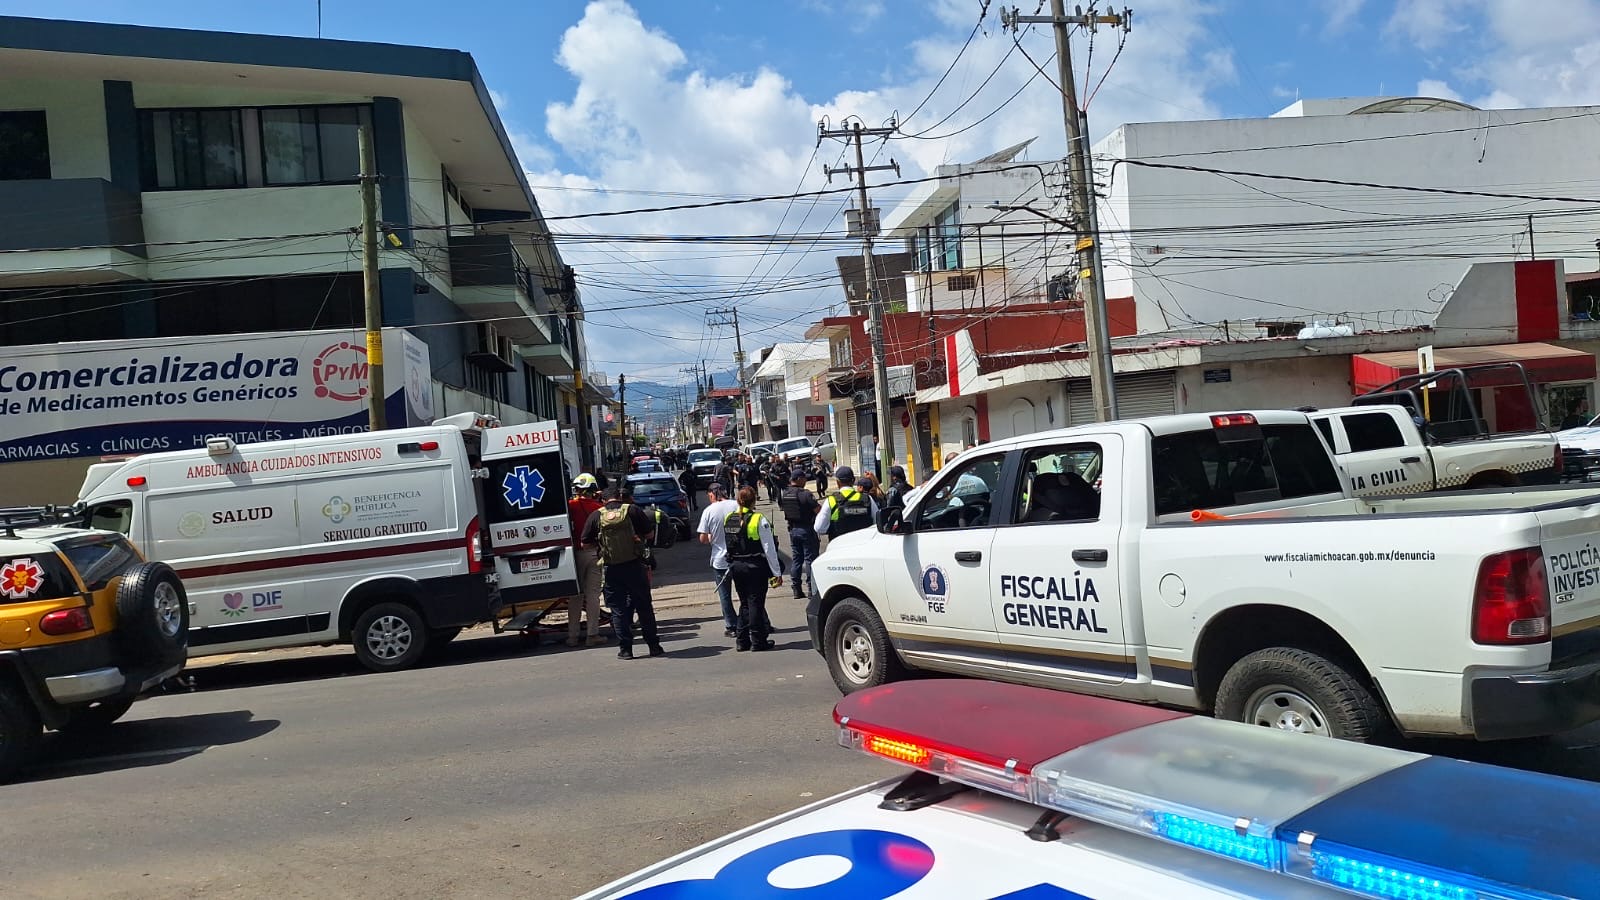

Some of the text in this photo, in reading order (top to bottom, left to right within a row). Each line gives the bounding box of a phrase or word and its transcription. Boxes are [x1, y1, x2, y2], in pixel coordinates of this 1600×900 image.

[0, 352, 299, 393] Comercializadora
[0, 385, 298, 415] de Medicamentos Genéricos
[101, 436, 170, 453] CLÍNICAS
[187, 447, 381, 478] AMBULANCIA CUIDADOS INTENSIVOS
[1371, 468, 1408, 487] CIVIL
[354, 490, 421, 503] BENEFICENCIA
[212, 506, 273, 525] SALUD
[323, 520, 428, 542] SERVICIO GRATUITO
[1264, 550, 1436, 562] www.fiscaliamichoacan.gob.mx/denuncia
[1550, 543, 1600, 573] POLICÍA
[1001, 570, 1100, 602] FISCALÍA
[252, 590, 282, 607] DIF
[928, 602, 946, 613] FGE
[1003, 603, 1108, 634] GENERAL
